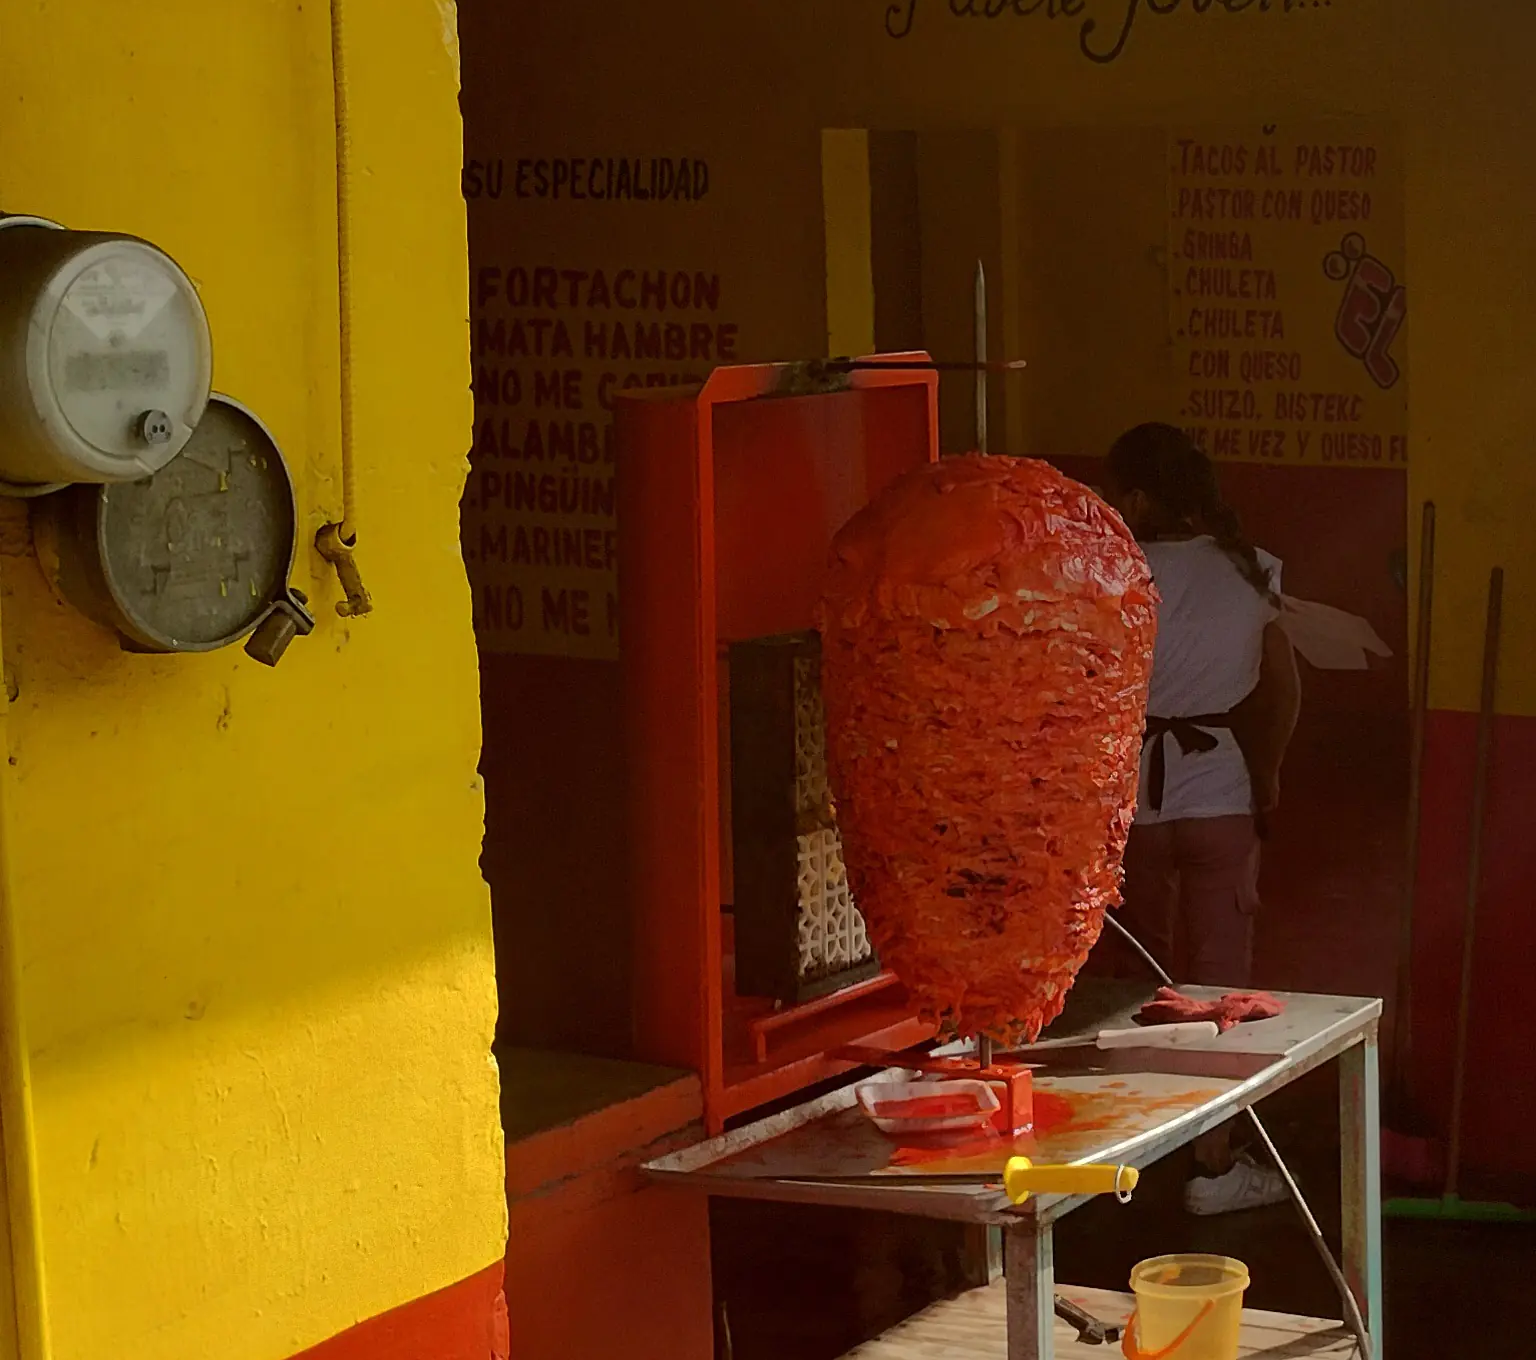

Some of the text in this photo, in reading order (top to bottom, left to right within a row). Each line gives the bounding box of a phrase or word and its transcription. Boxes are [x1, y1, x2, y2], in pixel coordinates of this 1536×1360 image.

[515, 157, 710, 203] ESPECIALIDAD
[1295, 144, 1378, 178] PASTOR
[1261, 189, 1301, 221] CON
[1310, 190, 1372, 225] QUESO
[476, 266, 721, 312] FORTACHON
[476, 316, 740, 362] MATA HAMBRE
[534, 369, 584, 411] ME
[480, 464, 615, 517] PINGÜIN
[540, 588, 591, 637] ME
